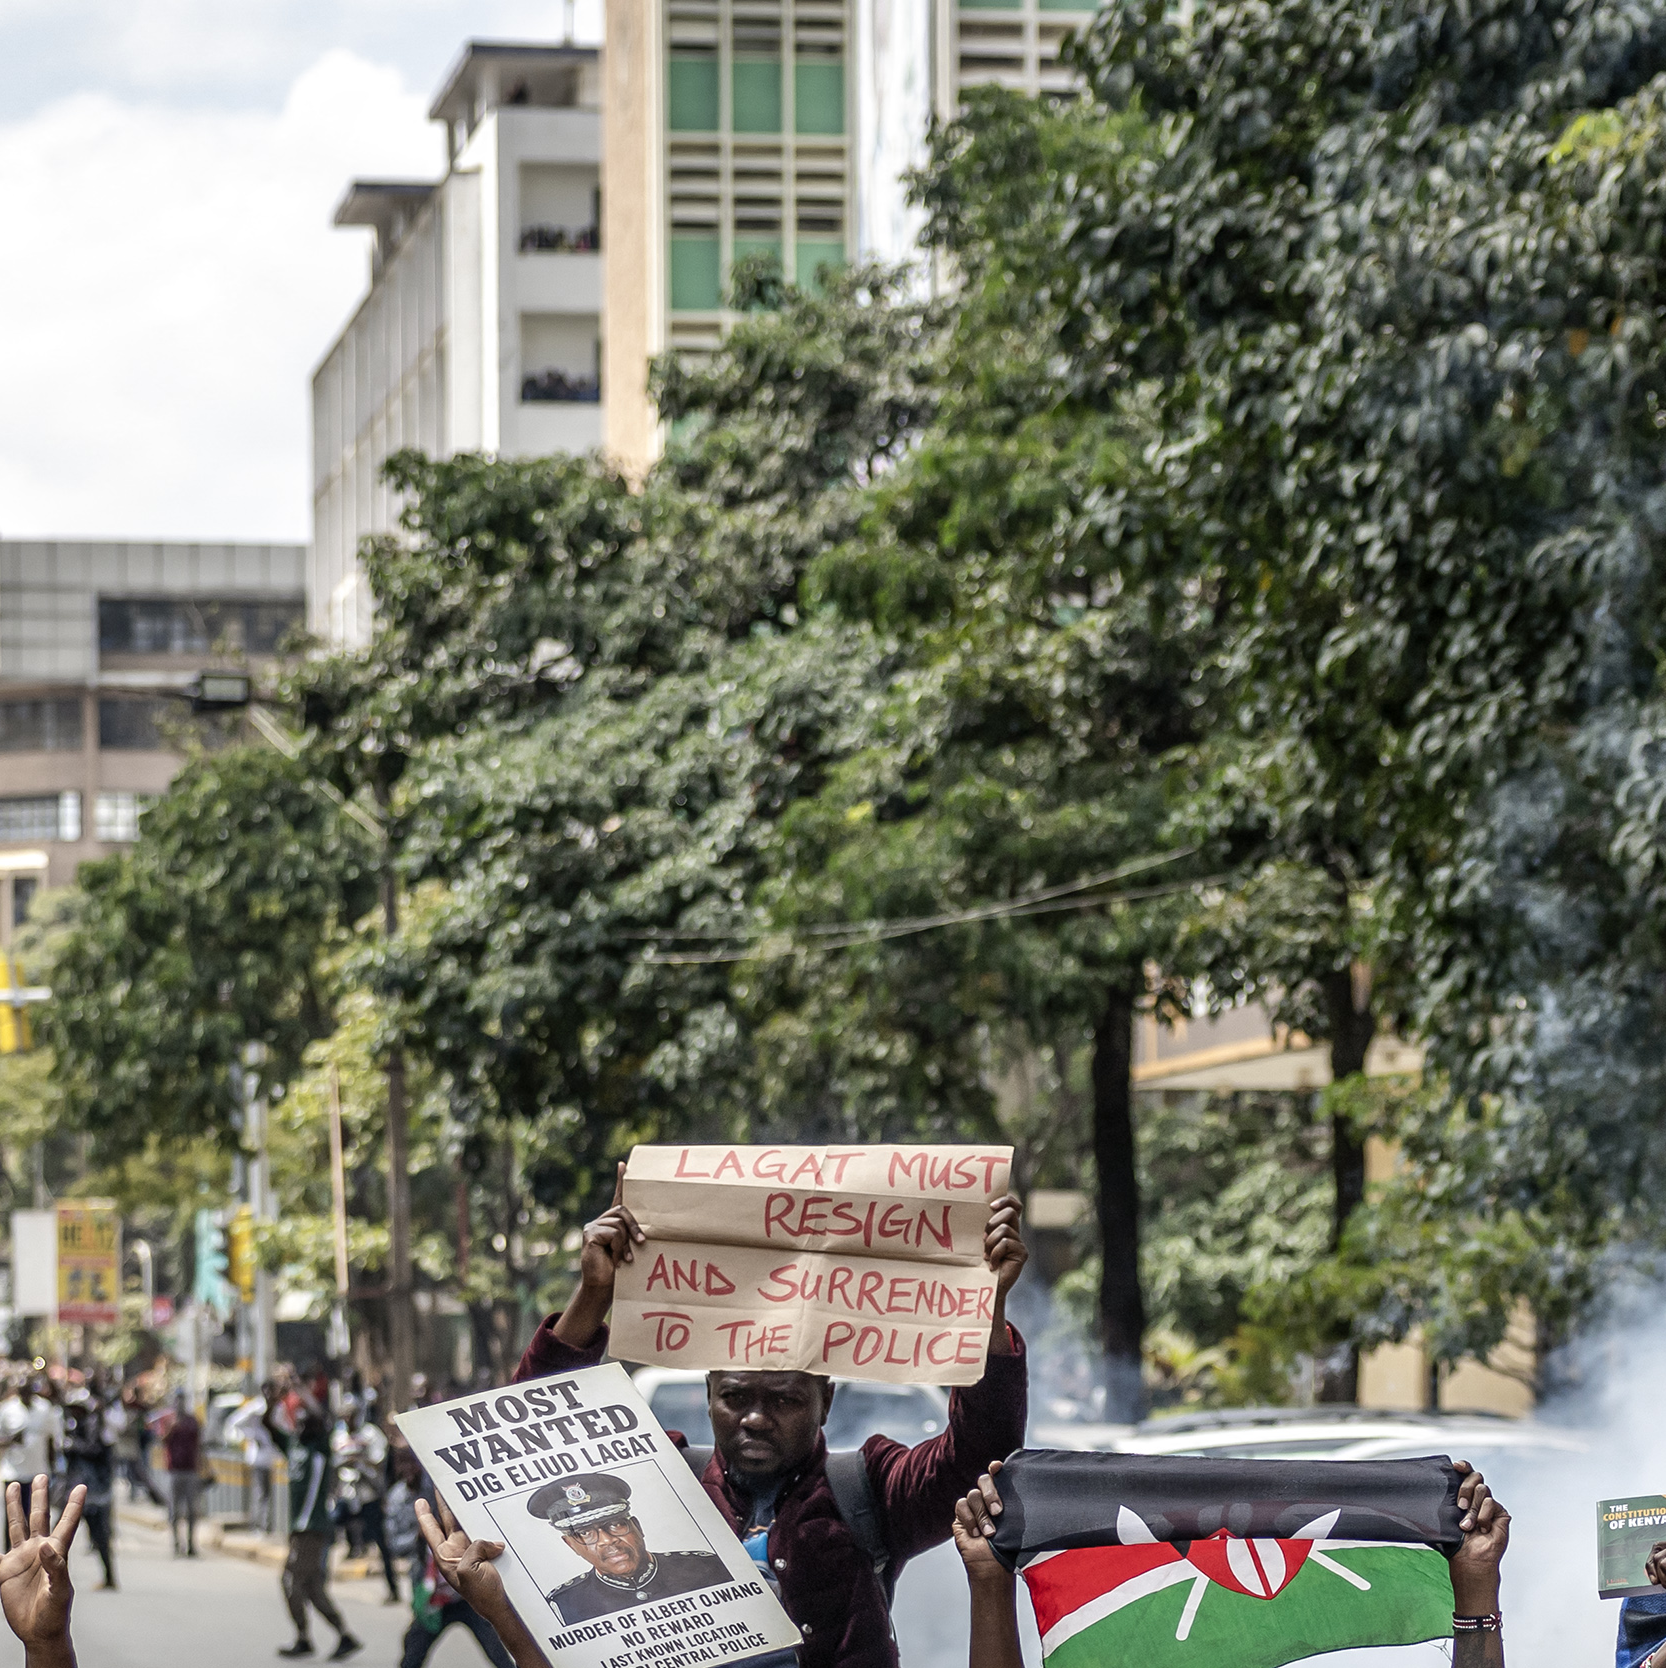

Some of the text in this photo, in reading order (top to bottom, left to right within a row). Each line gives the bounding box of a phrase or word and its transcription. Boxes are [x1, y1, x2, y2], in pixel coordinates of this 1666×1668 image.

[674, 1149, 1012, 1195] LAGAT MUST
[764, 1192, 954, 1252] RESIGN
[646, 1253, 994, 1321] AND SURRENDER
[641, 1311, 983, 1368] TO THE POLICE
[446, 1380, 584, 1437] MOST
[434, 1404, 639, 1475] WANTED
[455, 1433, 658, 1502] DIG ELIUD LAGAT
[1609, 1504, 1628, 1513] THE
[1609, 1519, 1626, 1530] OF
[548, 1581, 764, 1651] MURDER OF ALBERT OJWANG
[620, 1612, 716, 1649] NO REWARD
[635, 1638, 684, 1662] KNOWN
[685, 1621, 750, 1649] LOCATION
[720, 1633, 769, 1656] POLICE
